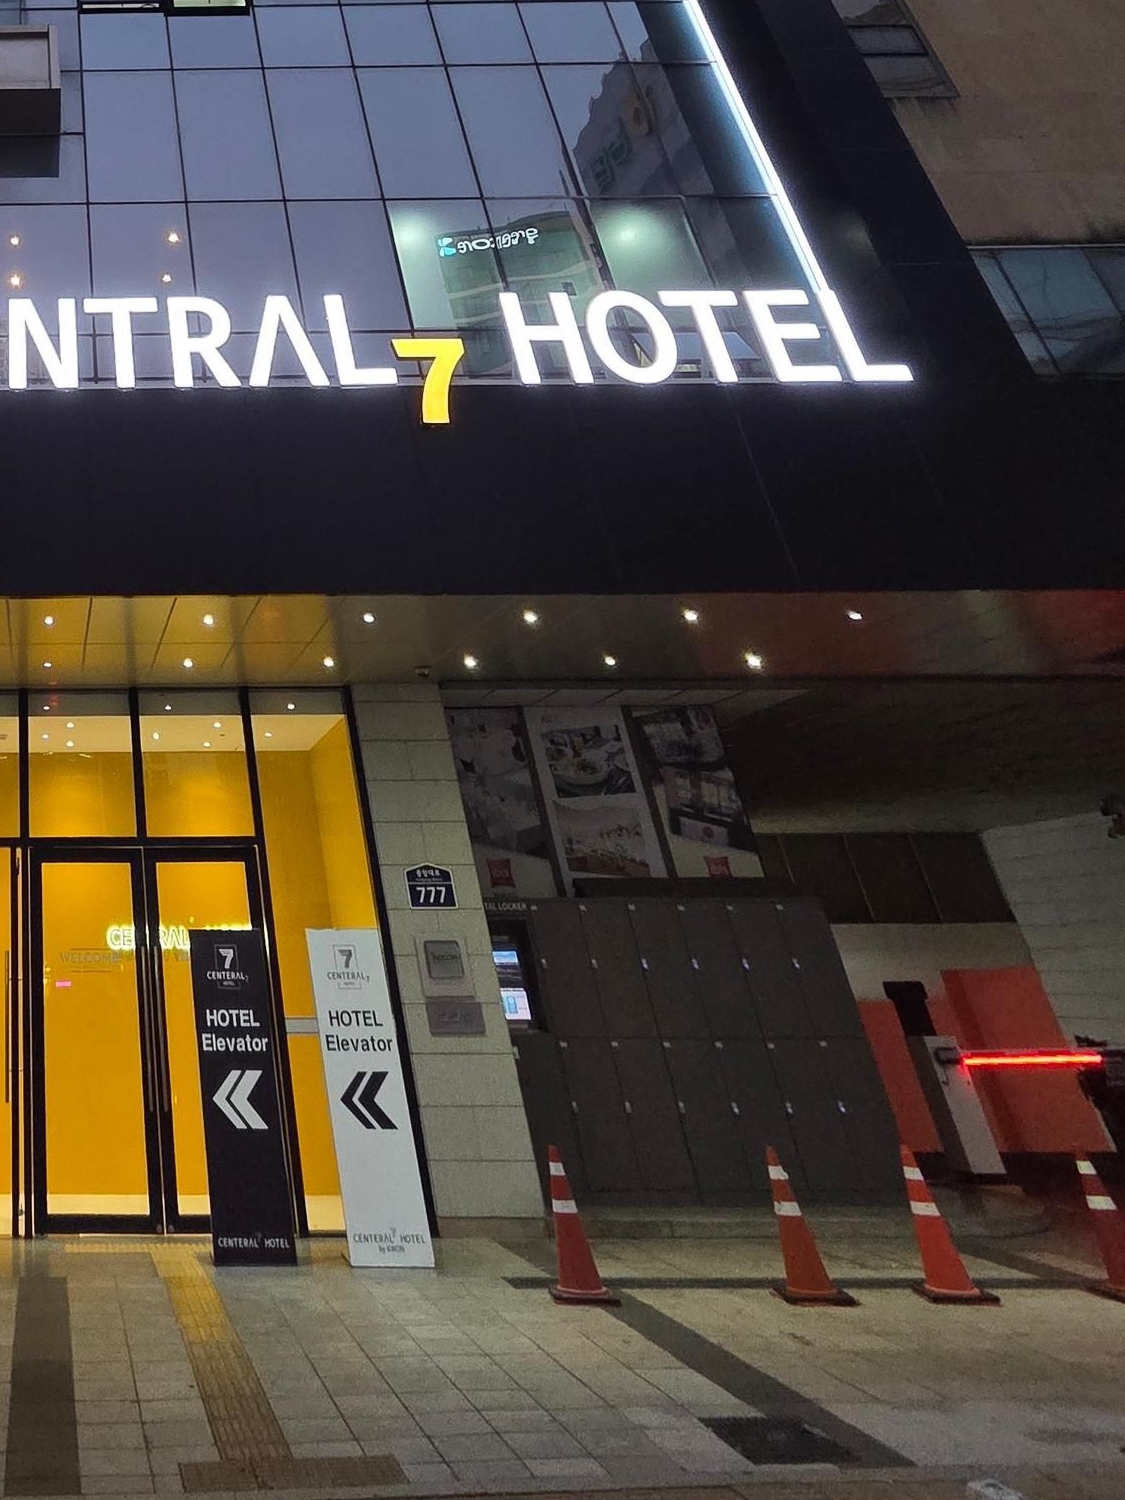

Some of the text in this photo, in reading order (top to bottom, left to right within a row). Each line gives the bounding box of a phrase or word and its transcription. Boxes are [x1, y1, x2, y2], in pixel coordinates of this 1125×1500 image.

[391, 337, 465, 424] 7
[499, 289, 915, 387] HOTEL
[416, 886, 446, 904] 777
[206, 971, 245, 981] CENTERAL
[327, 971, 365, 981] CENTERAL
[206, 1009, 260, 1027] HOTEL
[329, 1010, 383, 1027] HOTEL
[202, 1033, 268, 1051] Elevator
[326, 1034, 392, 1052] Elevator
[217, 1236, 259, 1249] CENTERAL
[264, 1237, 290, 1249] HOTEL
[353, 1233, 394, 1244] CENTERAL
[399, 1234, 426, 1244] HOTEL
